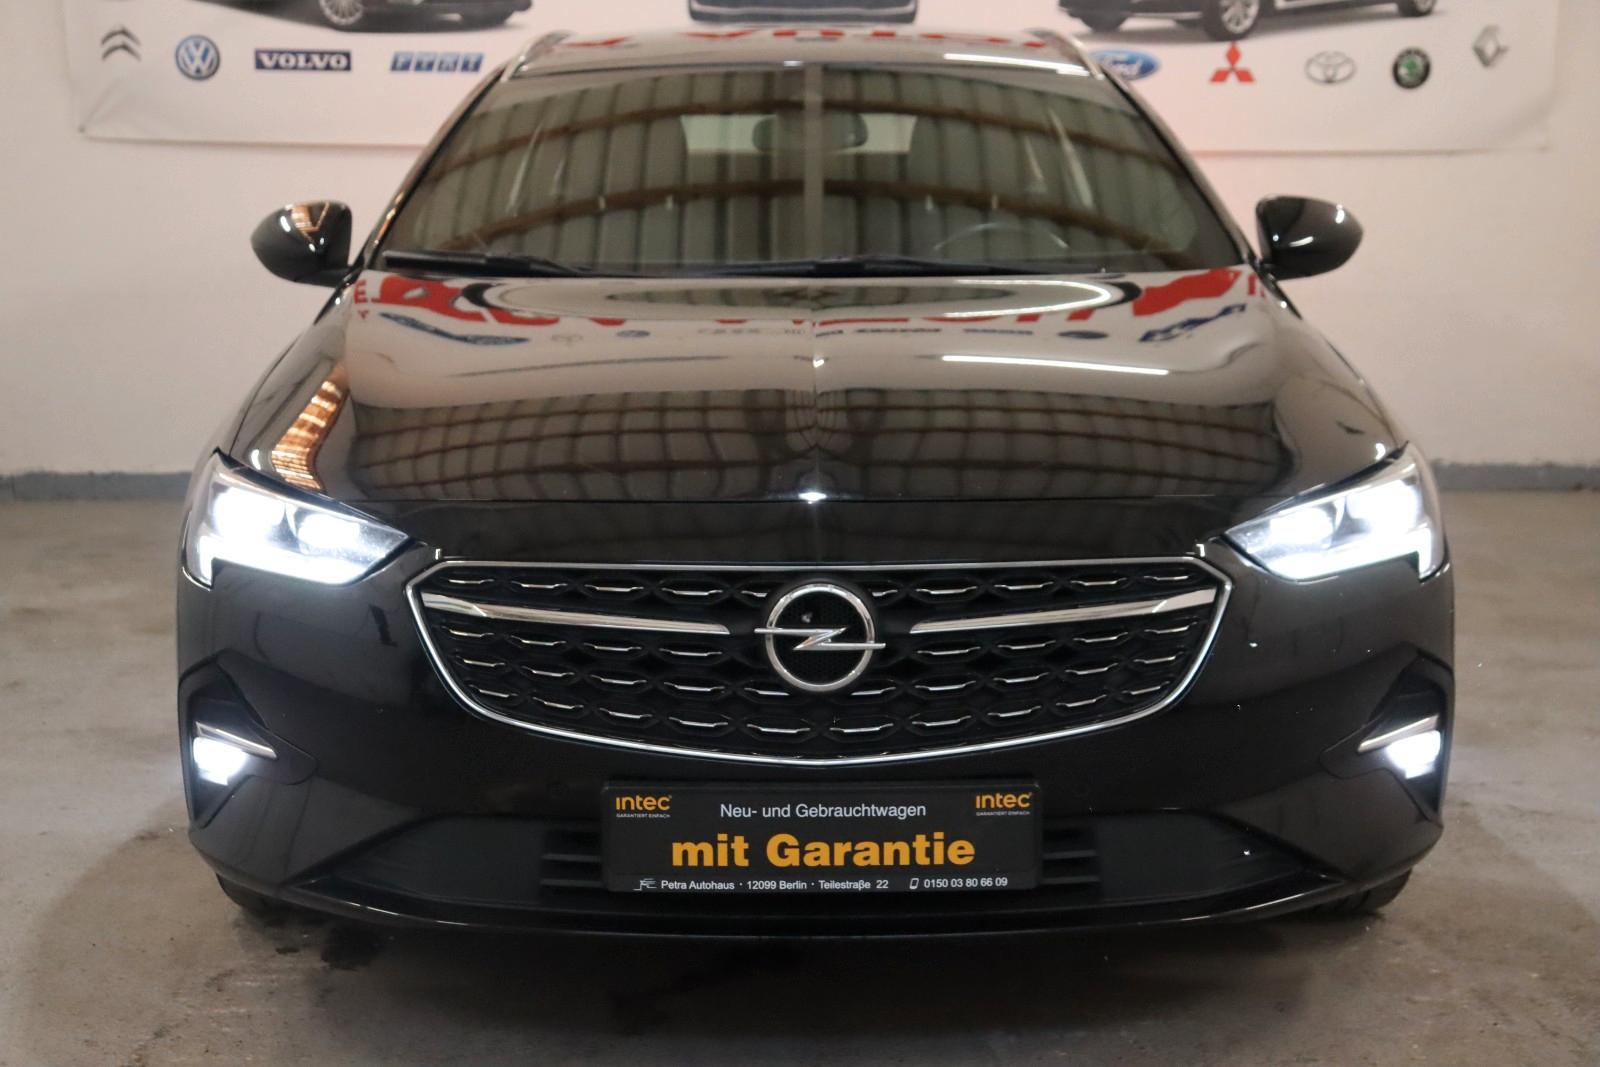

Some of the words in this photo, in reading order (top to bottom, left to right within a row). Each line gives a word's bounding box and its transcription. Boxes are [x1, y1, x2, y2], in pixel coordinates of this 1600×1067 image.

[259, 53, 348, 69] VOLVO
[616, 795, 670, 810] intec
[976, 793, 1030, 808] intec
[720, 804, 757, 818] Neu-
[762, 804, 791, 818] und
[795, 804, 926, 820] Gebrauchtwagen
[672, 833, 749, 867] mit
[766, 832, 976, 868] Garantie
[661, 880, 687, 890] Petra
[689, 880, 735, 890] Autohaus
[747, 881, 777, 890] 12099
[779, 880, 807, 890] Berlin
[818, 880, 871, 891] Teilestraße
[876, 880, 889, 889] 22
[924, 879, 949, 888] 0150
[951, 879, 964, 888] 03
[966, 879, 978, 887] 80
[980, 878, 993, 887] 66
[995, 877, 1008, 887] 09
